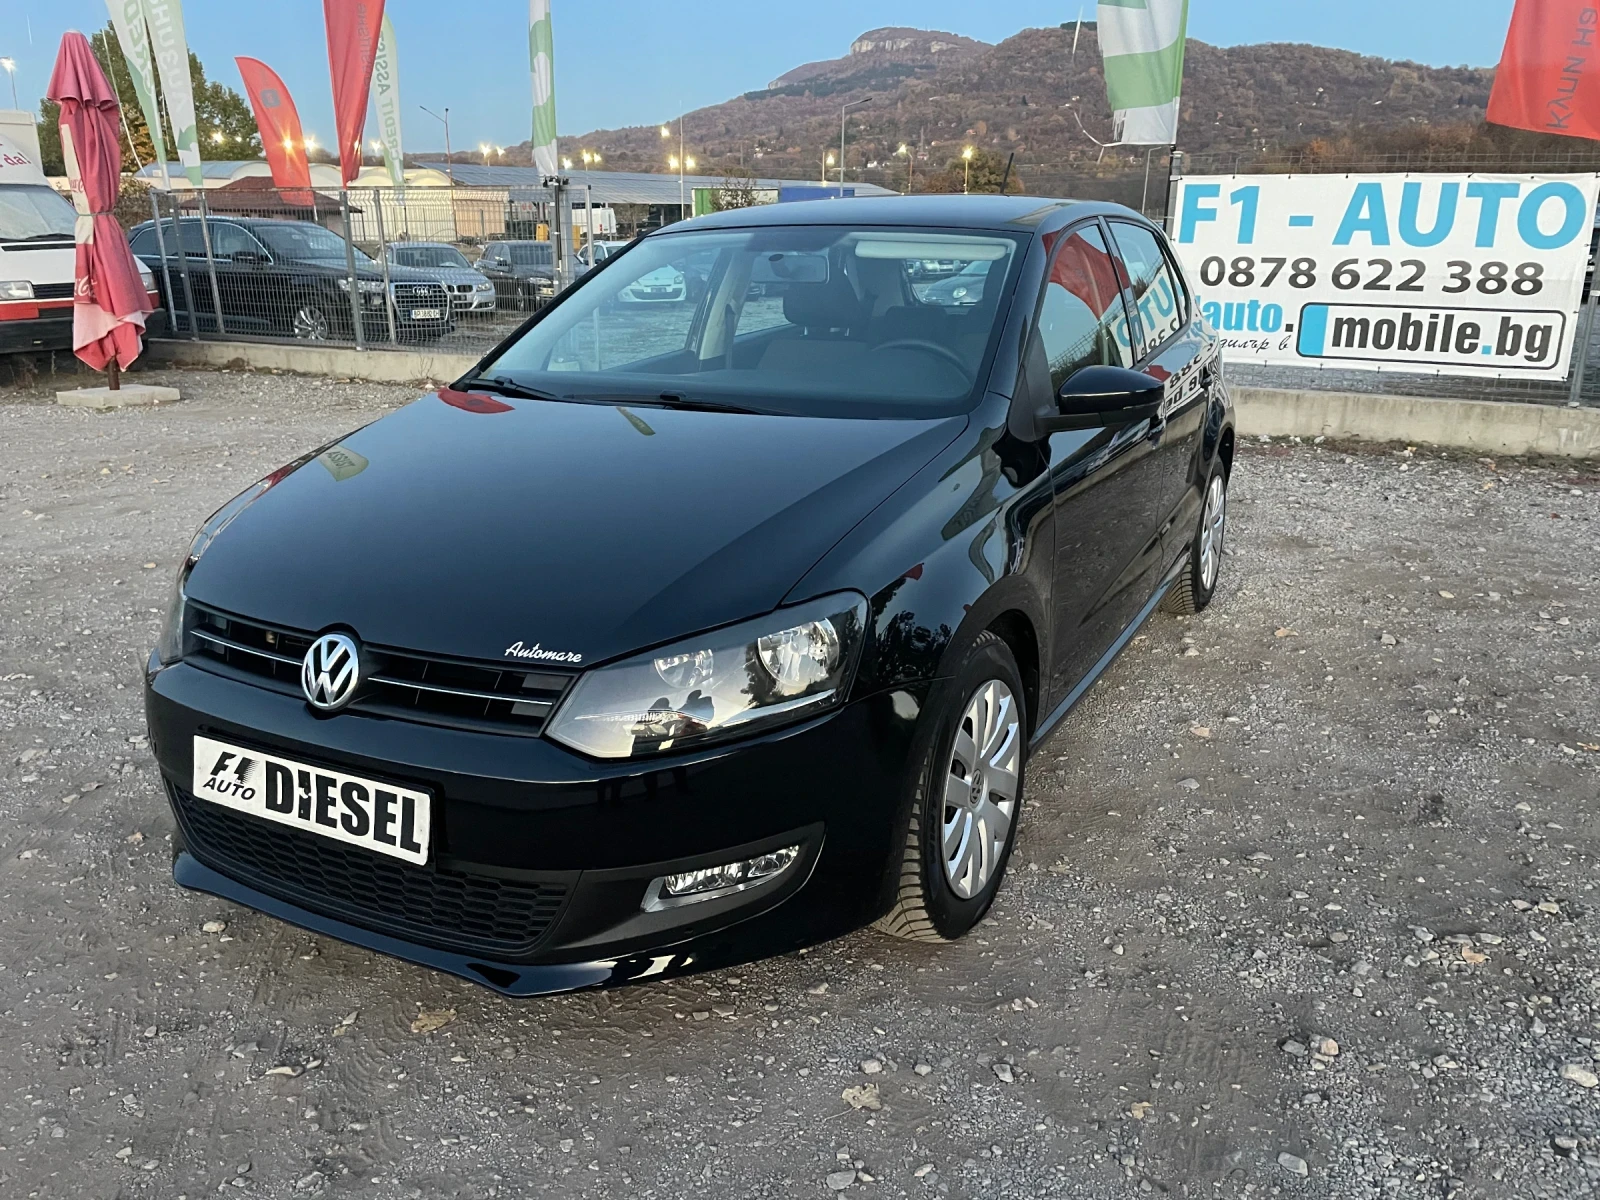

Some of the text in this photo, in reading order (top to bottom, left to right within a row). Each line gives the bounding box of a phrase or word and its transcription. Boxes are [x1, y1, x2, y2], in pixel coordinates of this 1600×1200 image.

[1178, 184, 1260, 245] F1
[1332, 181, 1586, 250] AUTO
[1200, 256, 1544, 295] 0878 622 388
[1331, 312, 1553, 362] mobile.bg
[504, 641, 582, 662] Automare
[203, 777, 256, 800] AUTO
[265, 760, 421, 854] DIESEL
